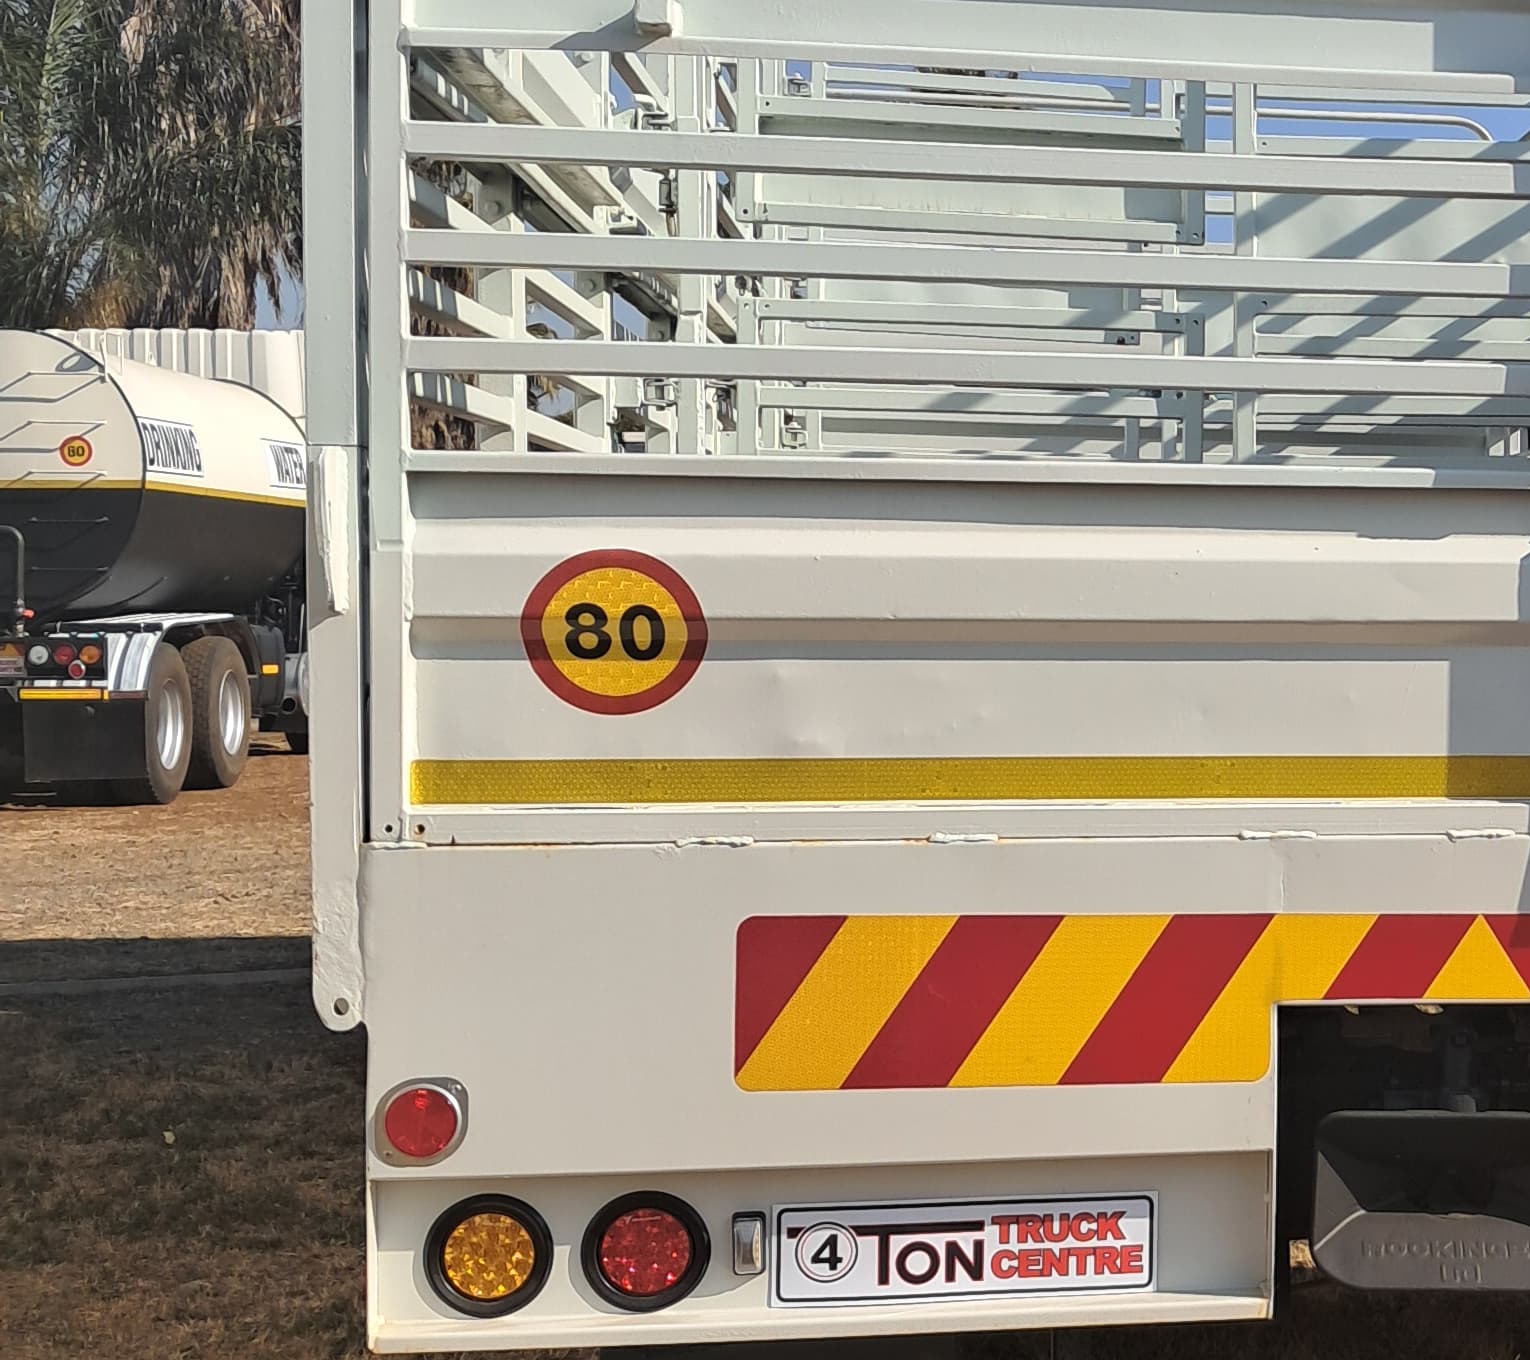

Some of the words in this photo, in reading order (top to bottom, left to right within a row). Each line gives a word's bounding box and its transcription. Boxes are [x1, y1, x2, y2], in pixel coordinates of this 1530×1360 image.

[141, 422, 202, 472] DRINKING
[269, 444, 307, 485] WATER
[564, 602, 666, 661] 80
[990, 1211, 1126, 1244] TRUCK
[990, 1245, 1144, 1280] CENTRE
